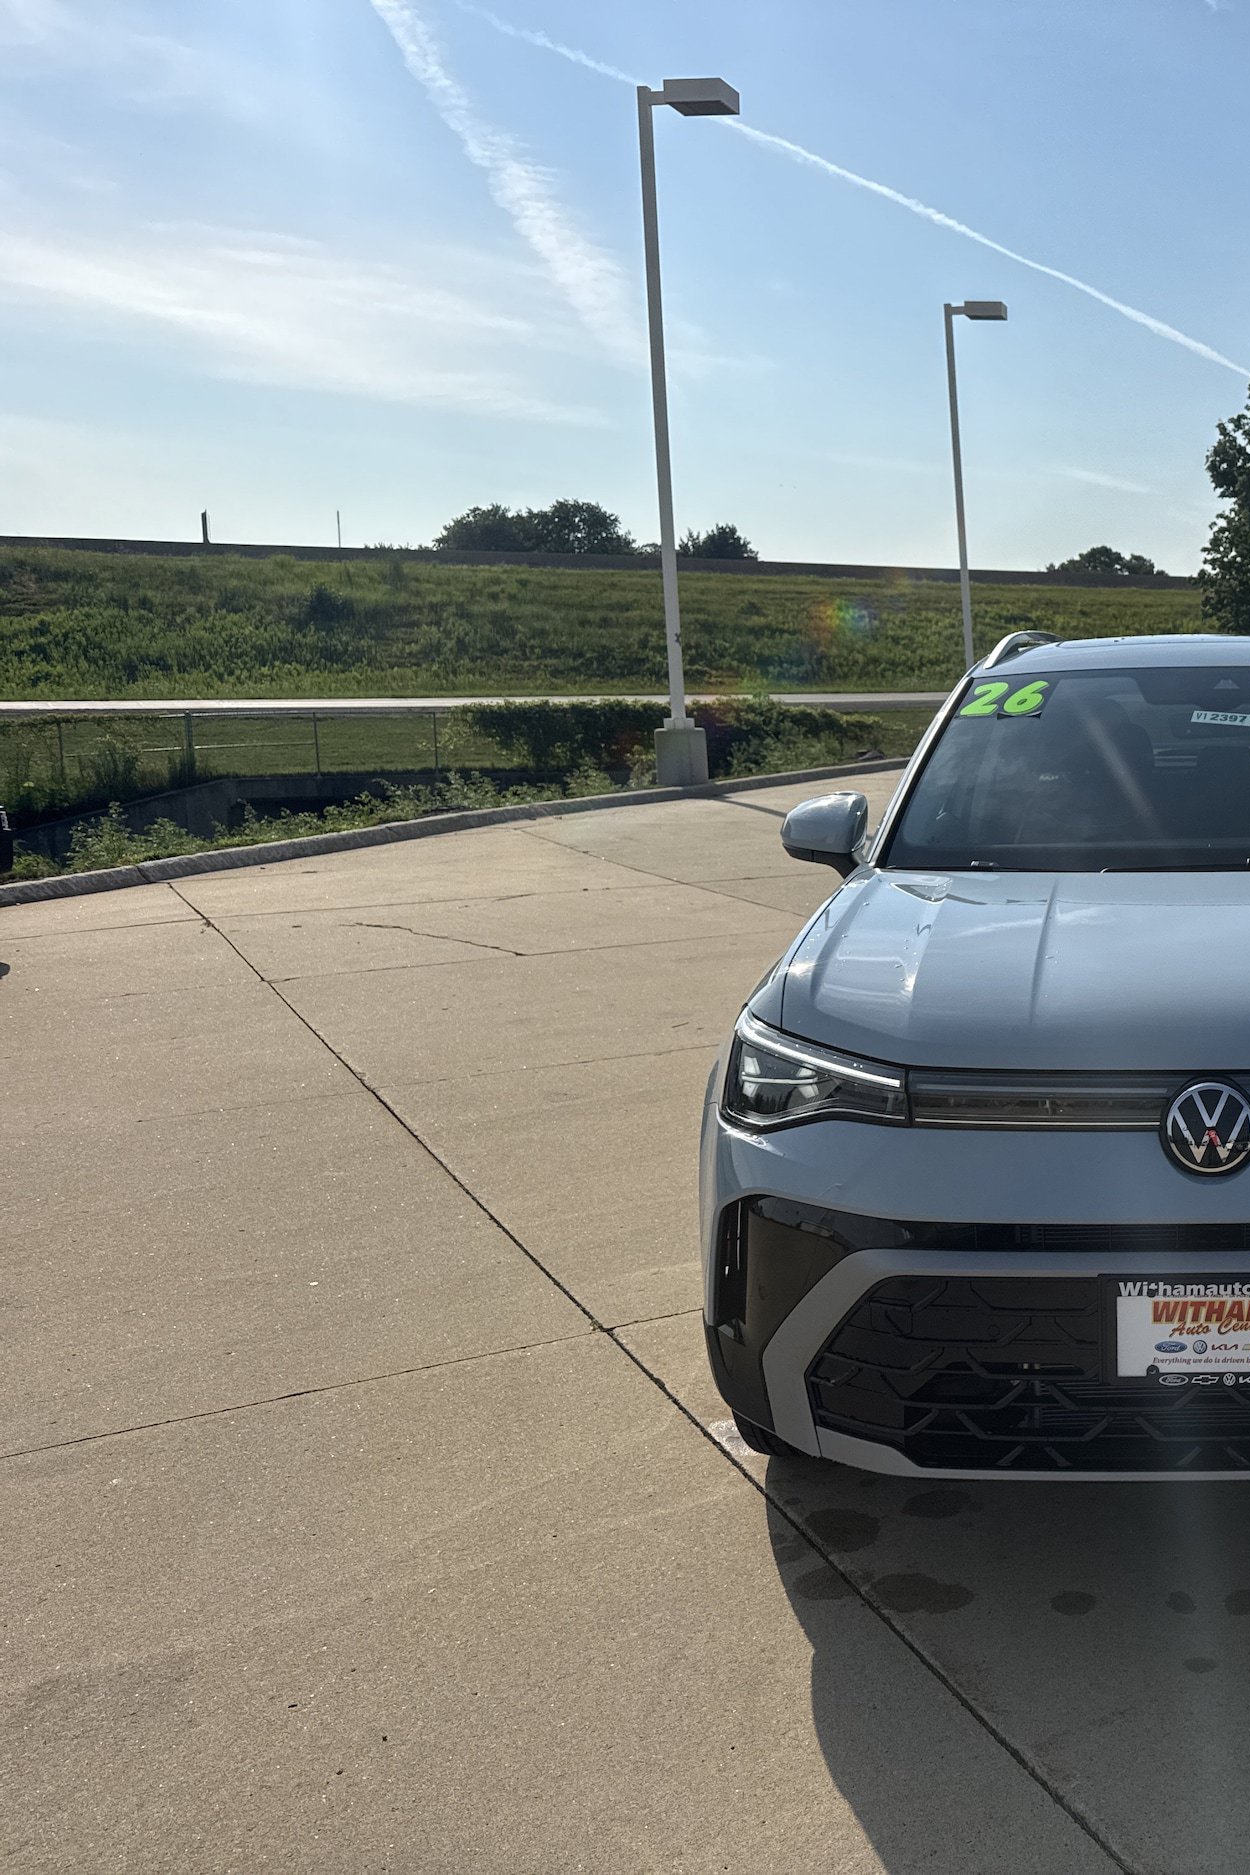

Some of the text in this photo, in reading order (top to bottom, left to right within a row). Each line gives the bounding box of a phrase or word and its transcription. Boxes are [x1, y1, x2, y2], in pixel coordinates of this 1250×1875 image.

[960, 681, 1049, 716] 26
[1210, 713, 1248, 723] 2397
[1169, 1321, 1211, 1337] Auto
[1153, 1356, 1191, 1366] Everything
[1203, 1356, 1213, 1364] do
[1214, 1356, 1221, 1364] is
[1221, 1356, 1245, 1364] driven
